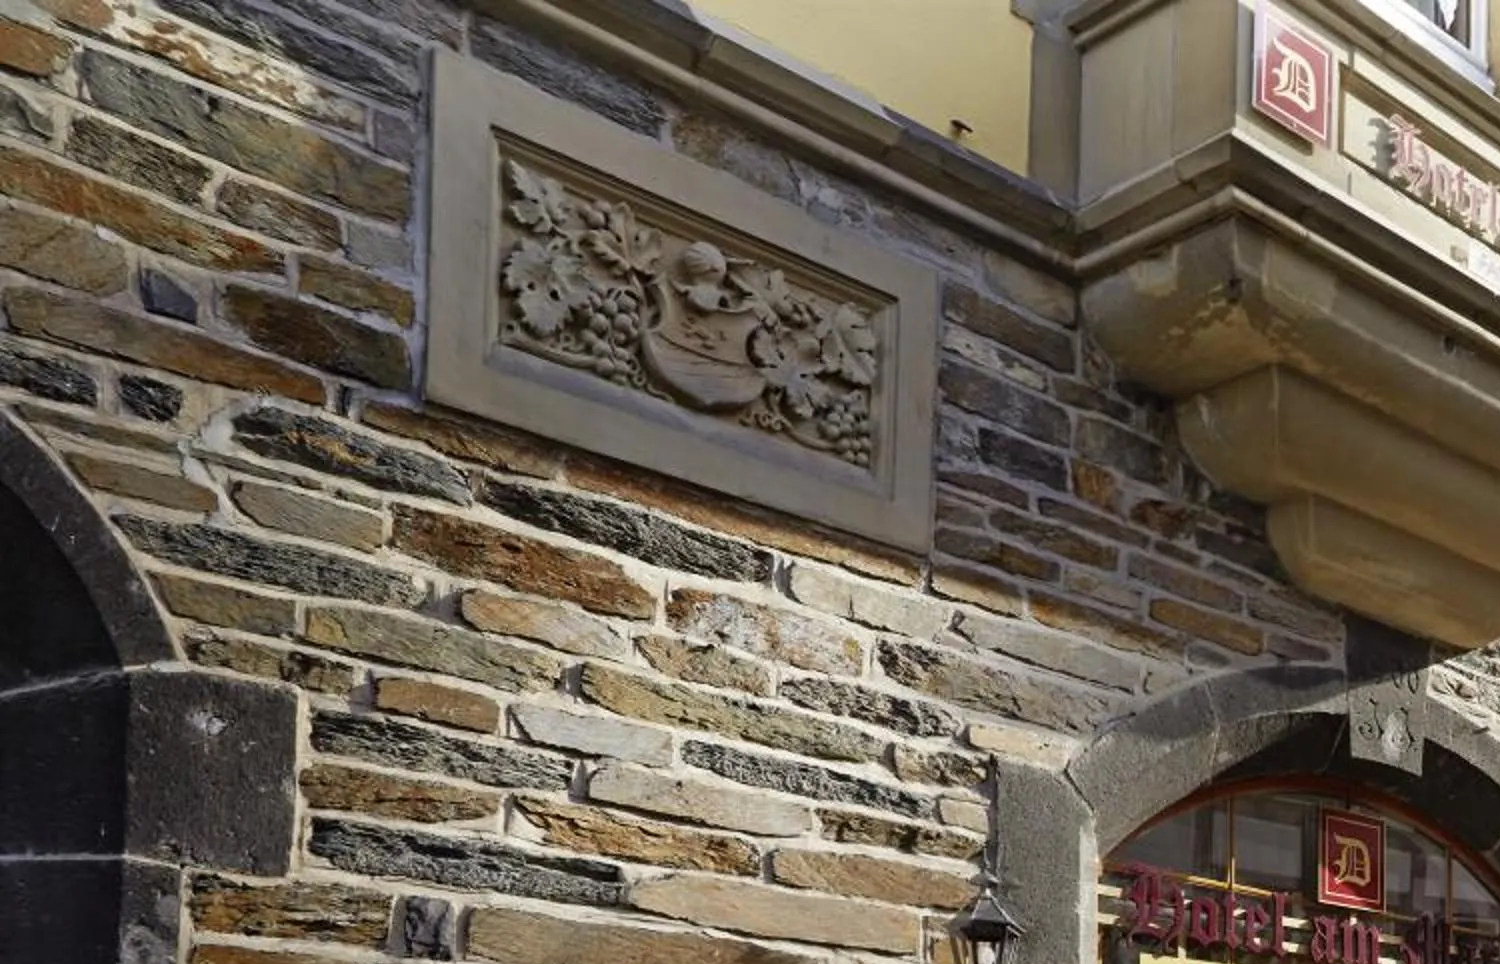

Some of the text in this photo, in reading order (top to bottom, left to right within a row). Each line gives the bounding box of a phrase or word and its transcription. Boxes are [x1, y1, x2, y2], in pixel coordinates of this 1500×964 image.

[1271, 38, 1316, 114] D
[1333, 834, 1371, 888] D
[1126, 862, 1291, 957] Hotel
